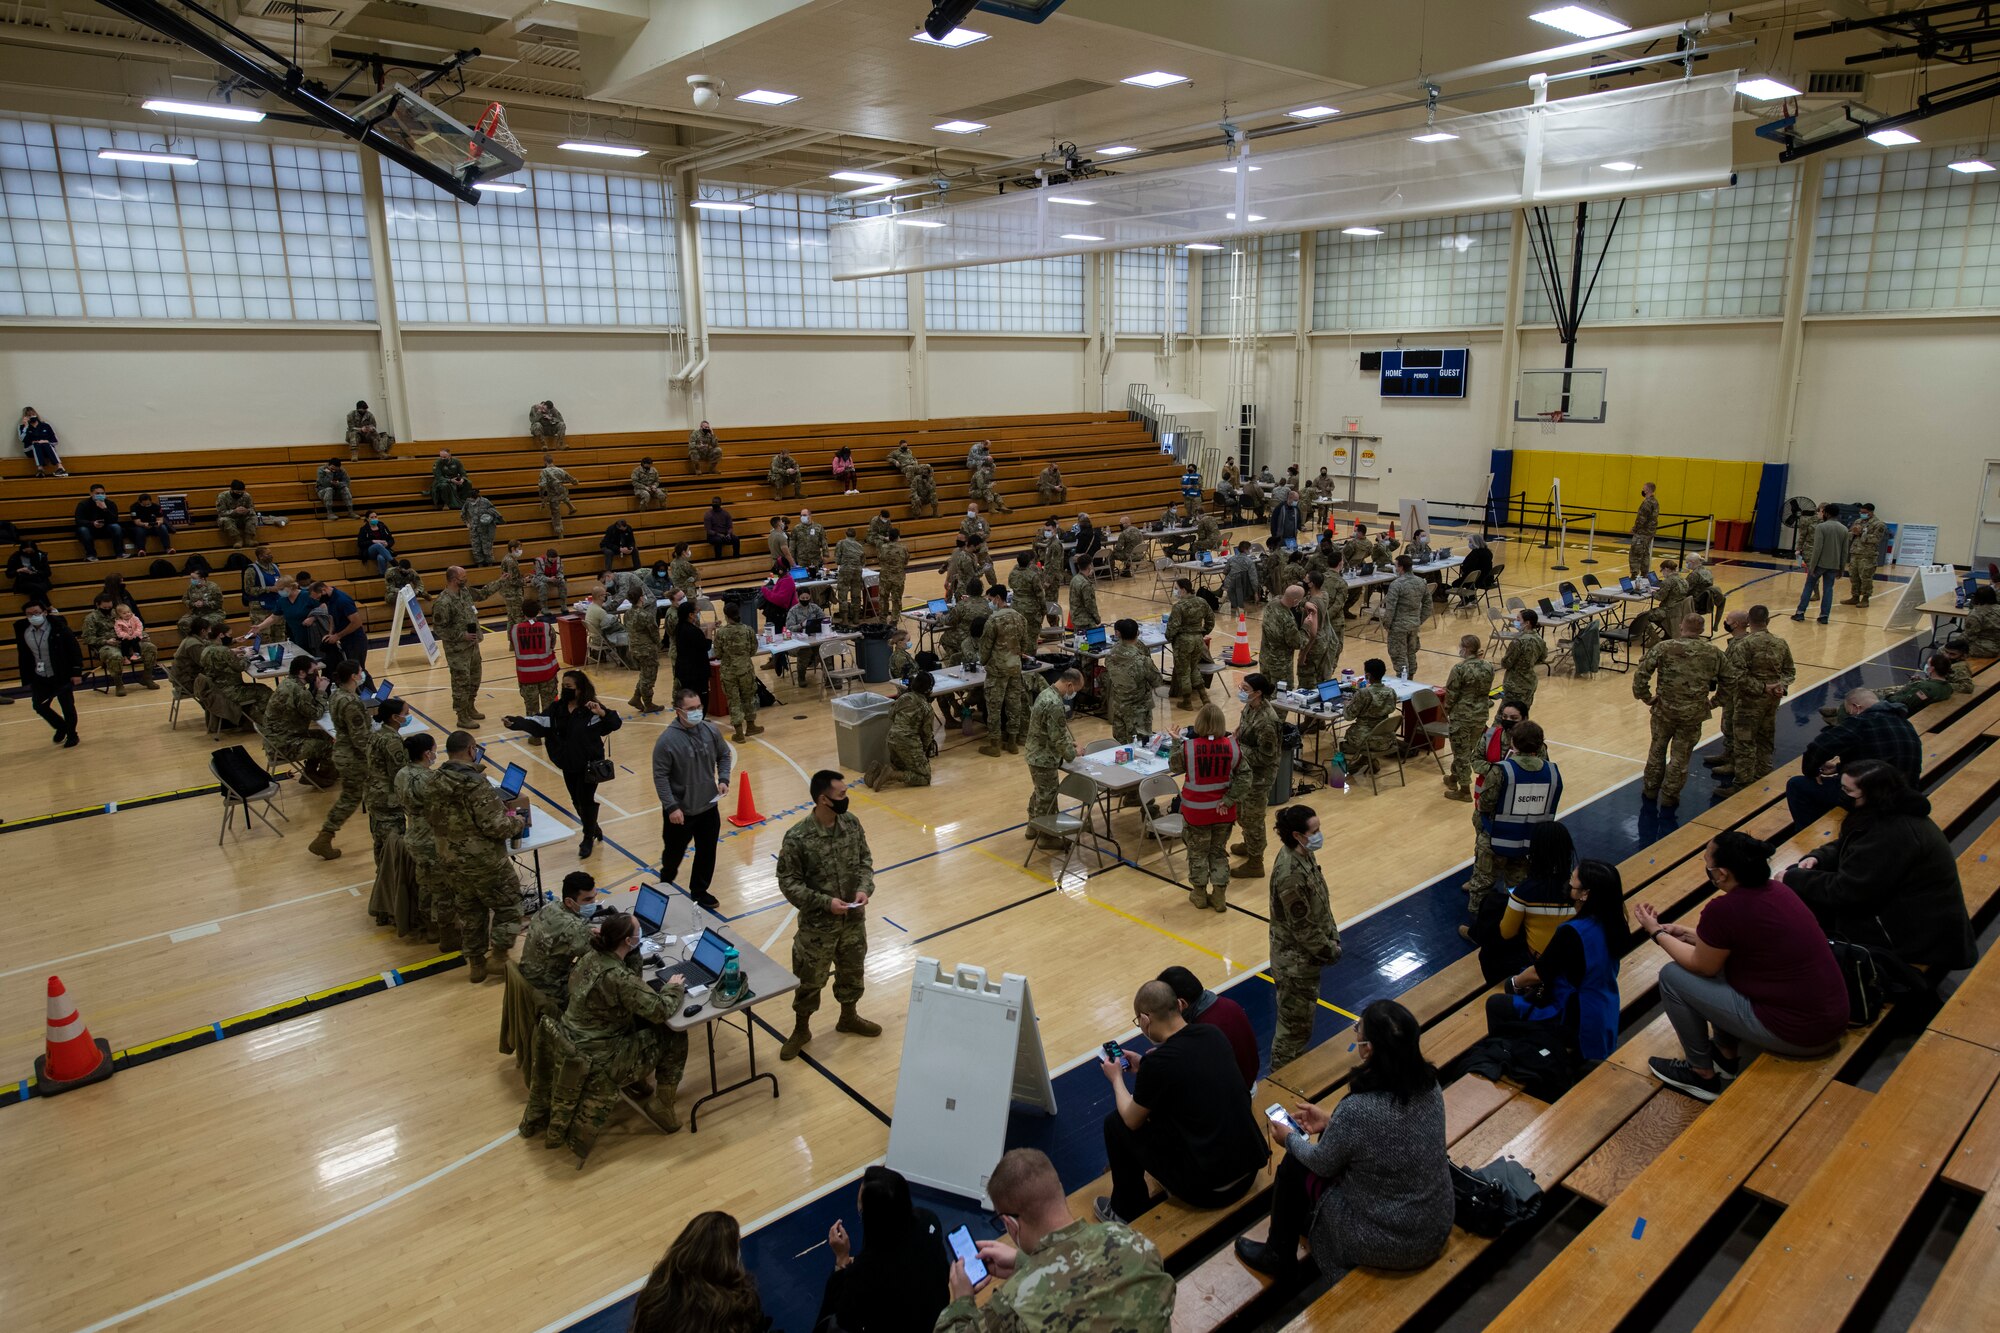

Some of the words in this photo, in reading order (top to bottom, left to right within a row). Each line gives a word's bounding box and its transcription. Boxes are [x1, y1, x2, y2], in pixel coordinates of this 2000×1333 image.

[1385, 369, 1402, 377] HOME
[1439, 369, 1461, 377] GUEST
[520, 635, 544, 650] WIT
[1198, 756, 1230, 777] WIT
